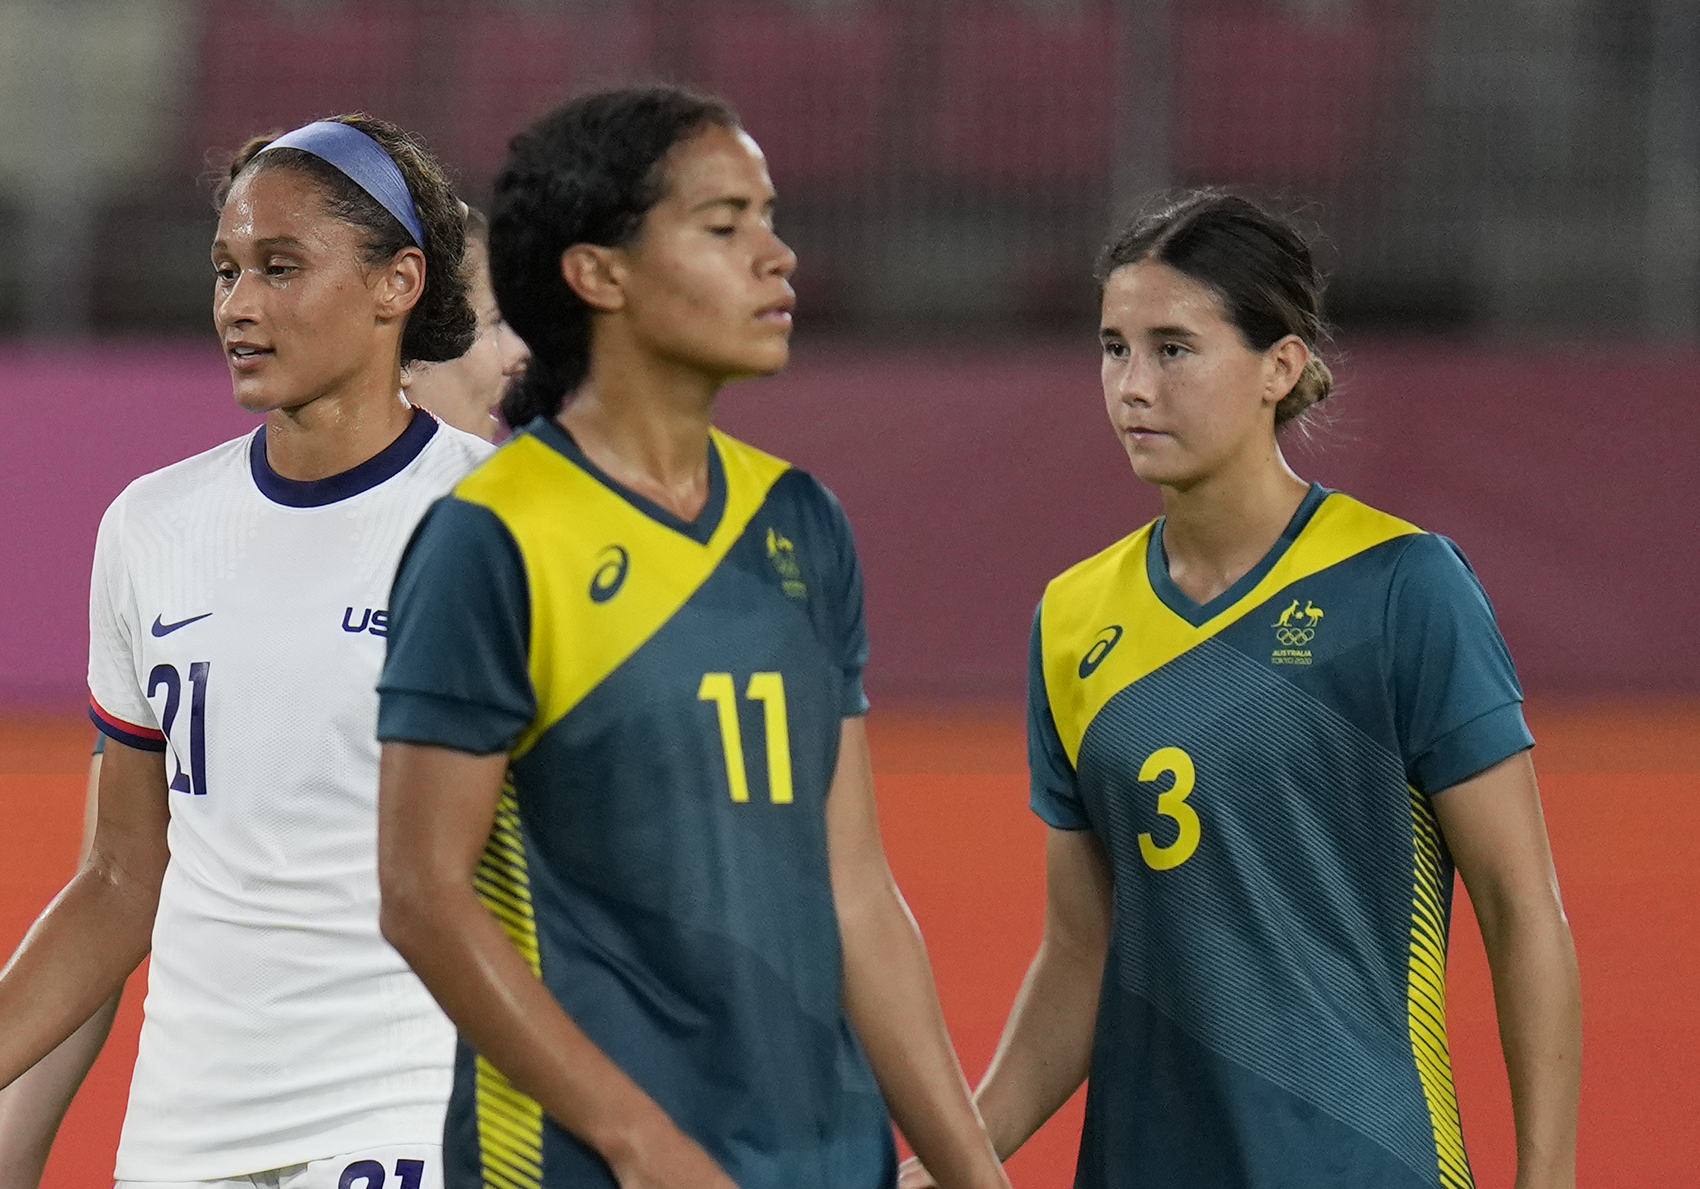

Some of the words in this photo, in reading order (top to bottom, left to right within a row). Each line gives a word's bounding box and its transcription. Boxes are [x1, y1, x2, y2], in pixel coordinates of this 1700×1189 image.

[341, 607, 389, 638] US
[147, 661, 210, 795] 21
[697, 672, 794, 804] 11
[1138, 746, 1202, 871] 3
